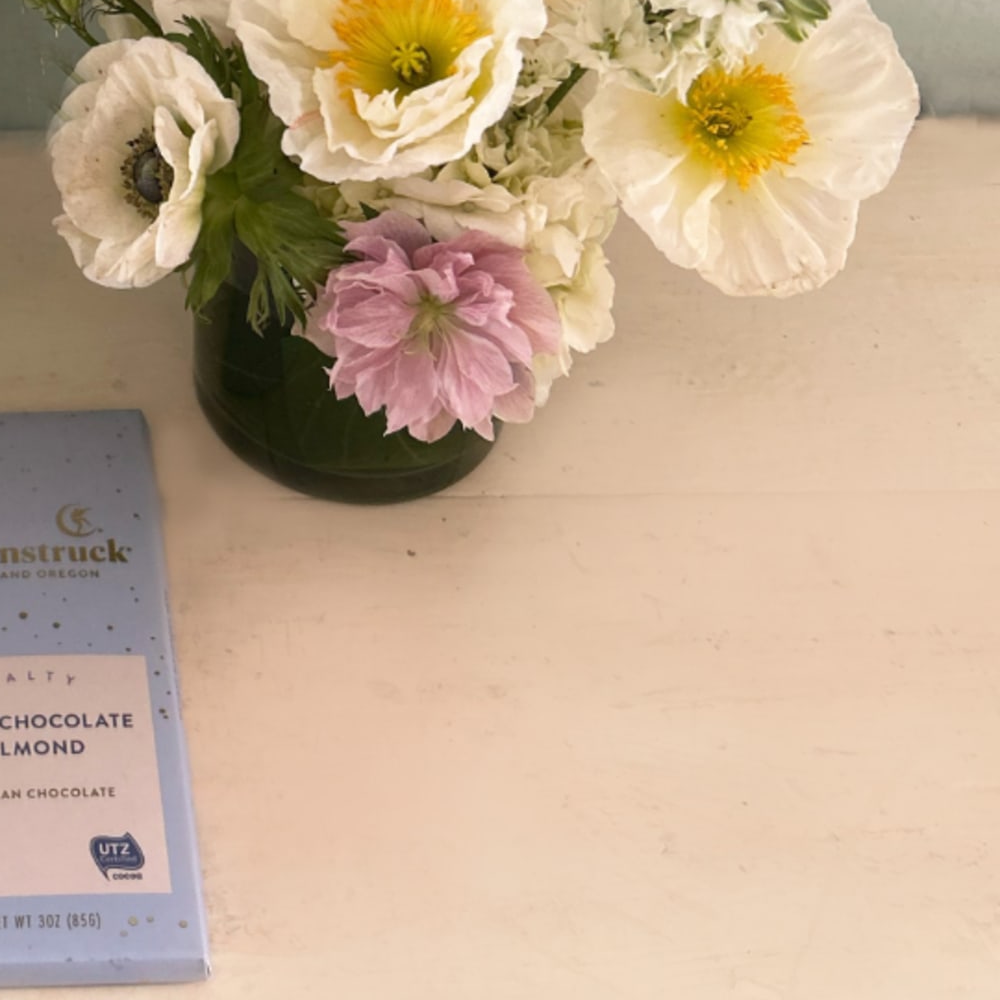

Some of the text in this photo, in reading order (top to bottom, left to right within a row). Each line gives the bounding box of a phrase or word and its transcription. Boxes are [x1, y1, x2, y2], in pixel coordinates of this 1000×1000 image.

[36, 568, 101, 580] OREGON
[26, 787, 116, 799] CHOCOLATE
[98, 841, 131, 855] UTZ
[14, 914, 34, 929] WT
